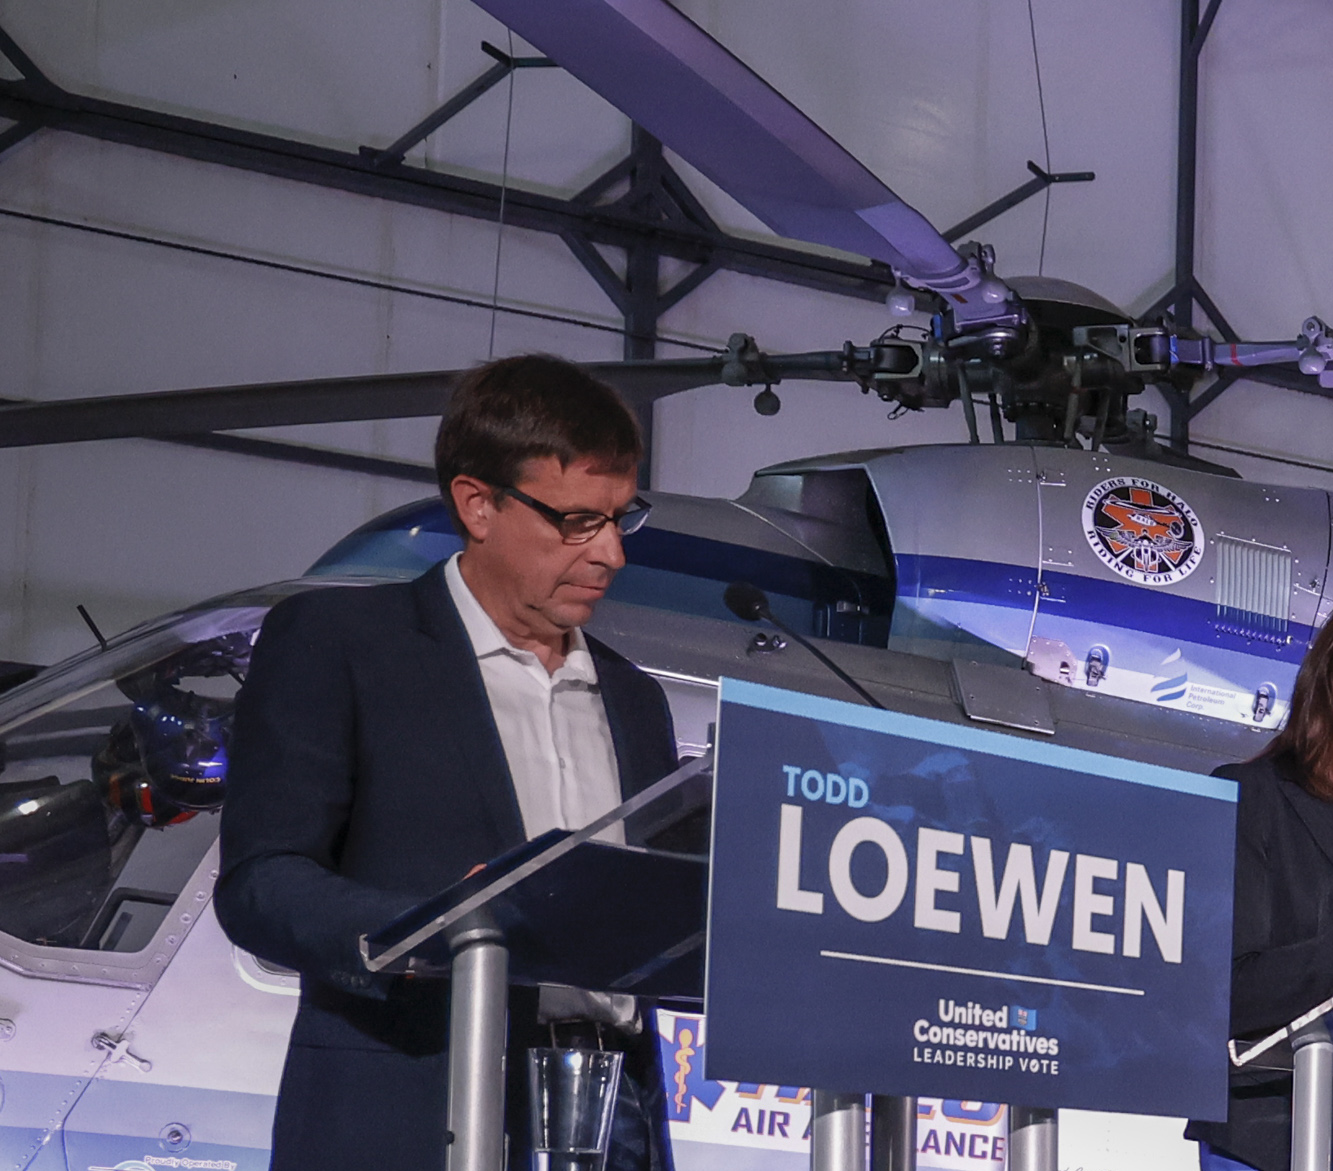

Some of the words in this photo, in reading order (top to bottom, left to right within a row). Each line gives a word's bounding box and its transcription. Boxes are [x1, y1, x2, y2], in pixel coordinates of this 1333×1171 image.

[1085, 478, 1126, 511] RIDERS
[1131, 478, 1160, 492] FOR
[1166, 491, 1198, 527] HALO
[1087, 530, 1134, 578] RIDING
[1143, 573, 1173, 584] FOR
[1178, 546, 1201, 576] LIFE
[1188, 693, 1225, 705] Petroleum
[1190, 685, 1237, 699] International
[782, 765, 870, 808] TODD
[776, 803, 1186, 964] LOEWEN
[938, 999, 1008, 1029] United
[913, 1019, 1059, 1056] Conservatives
[913, 1047, 1014, 1071] LEADERSHIP
[1019, 1057, 1059, 1076] VOTE
[730, 1106, 790, 1139] AIR
[144, 1155, 179, 1168] Proudly
[180, 1157, 222, 1170] Operated
[223, 1160, 237, 1171] By
